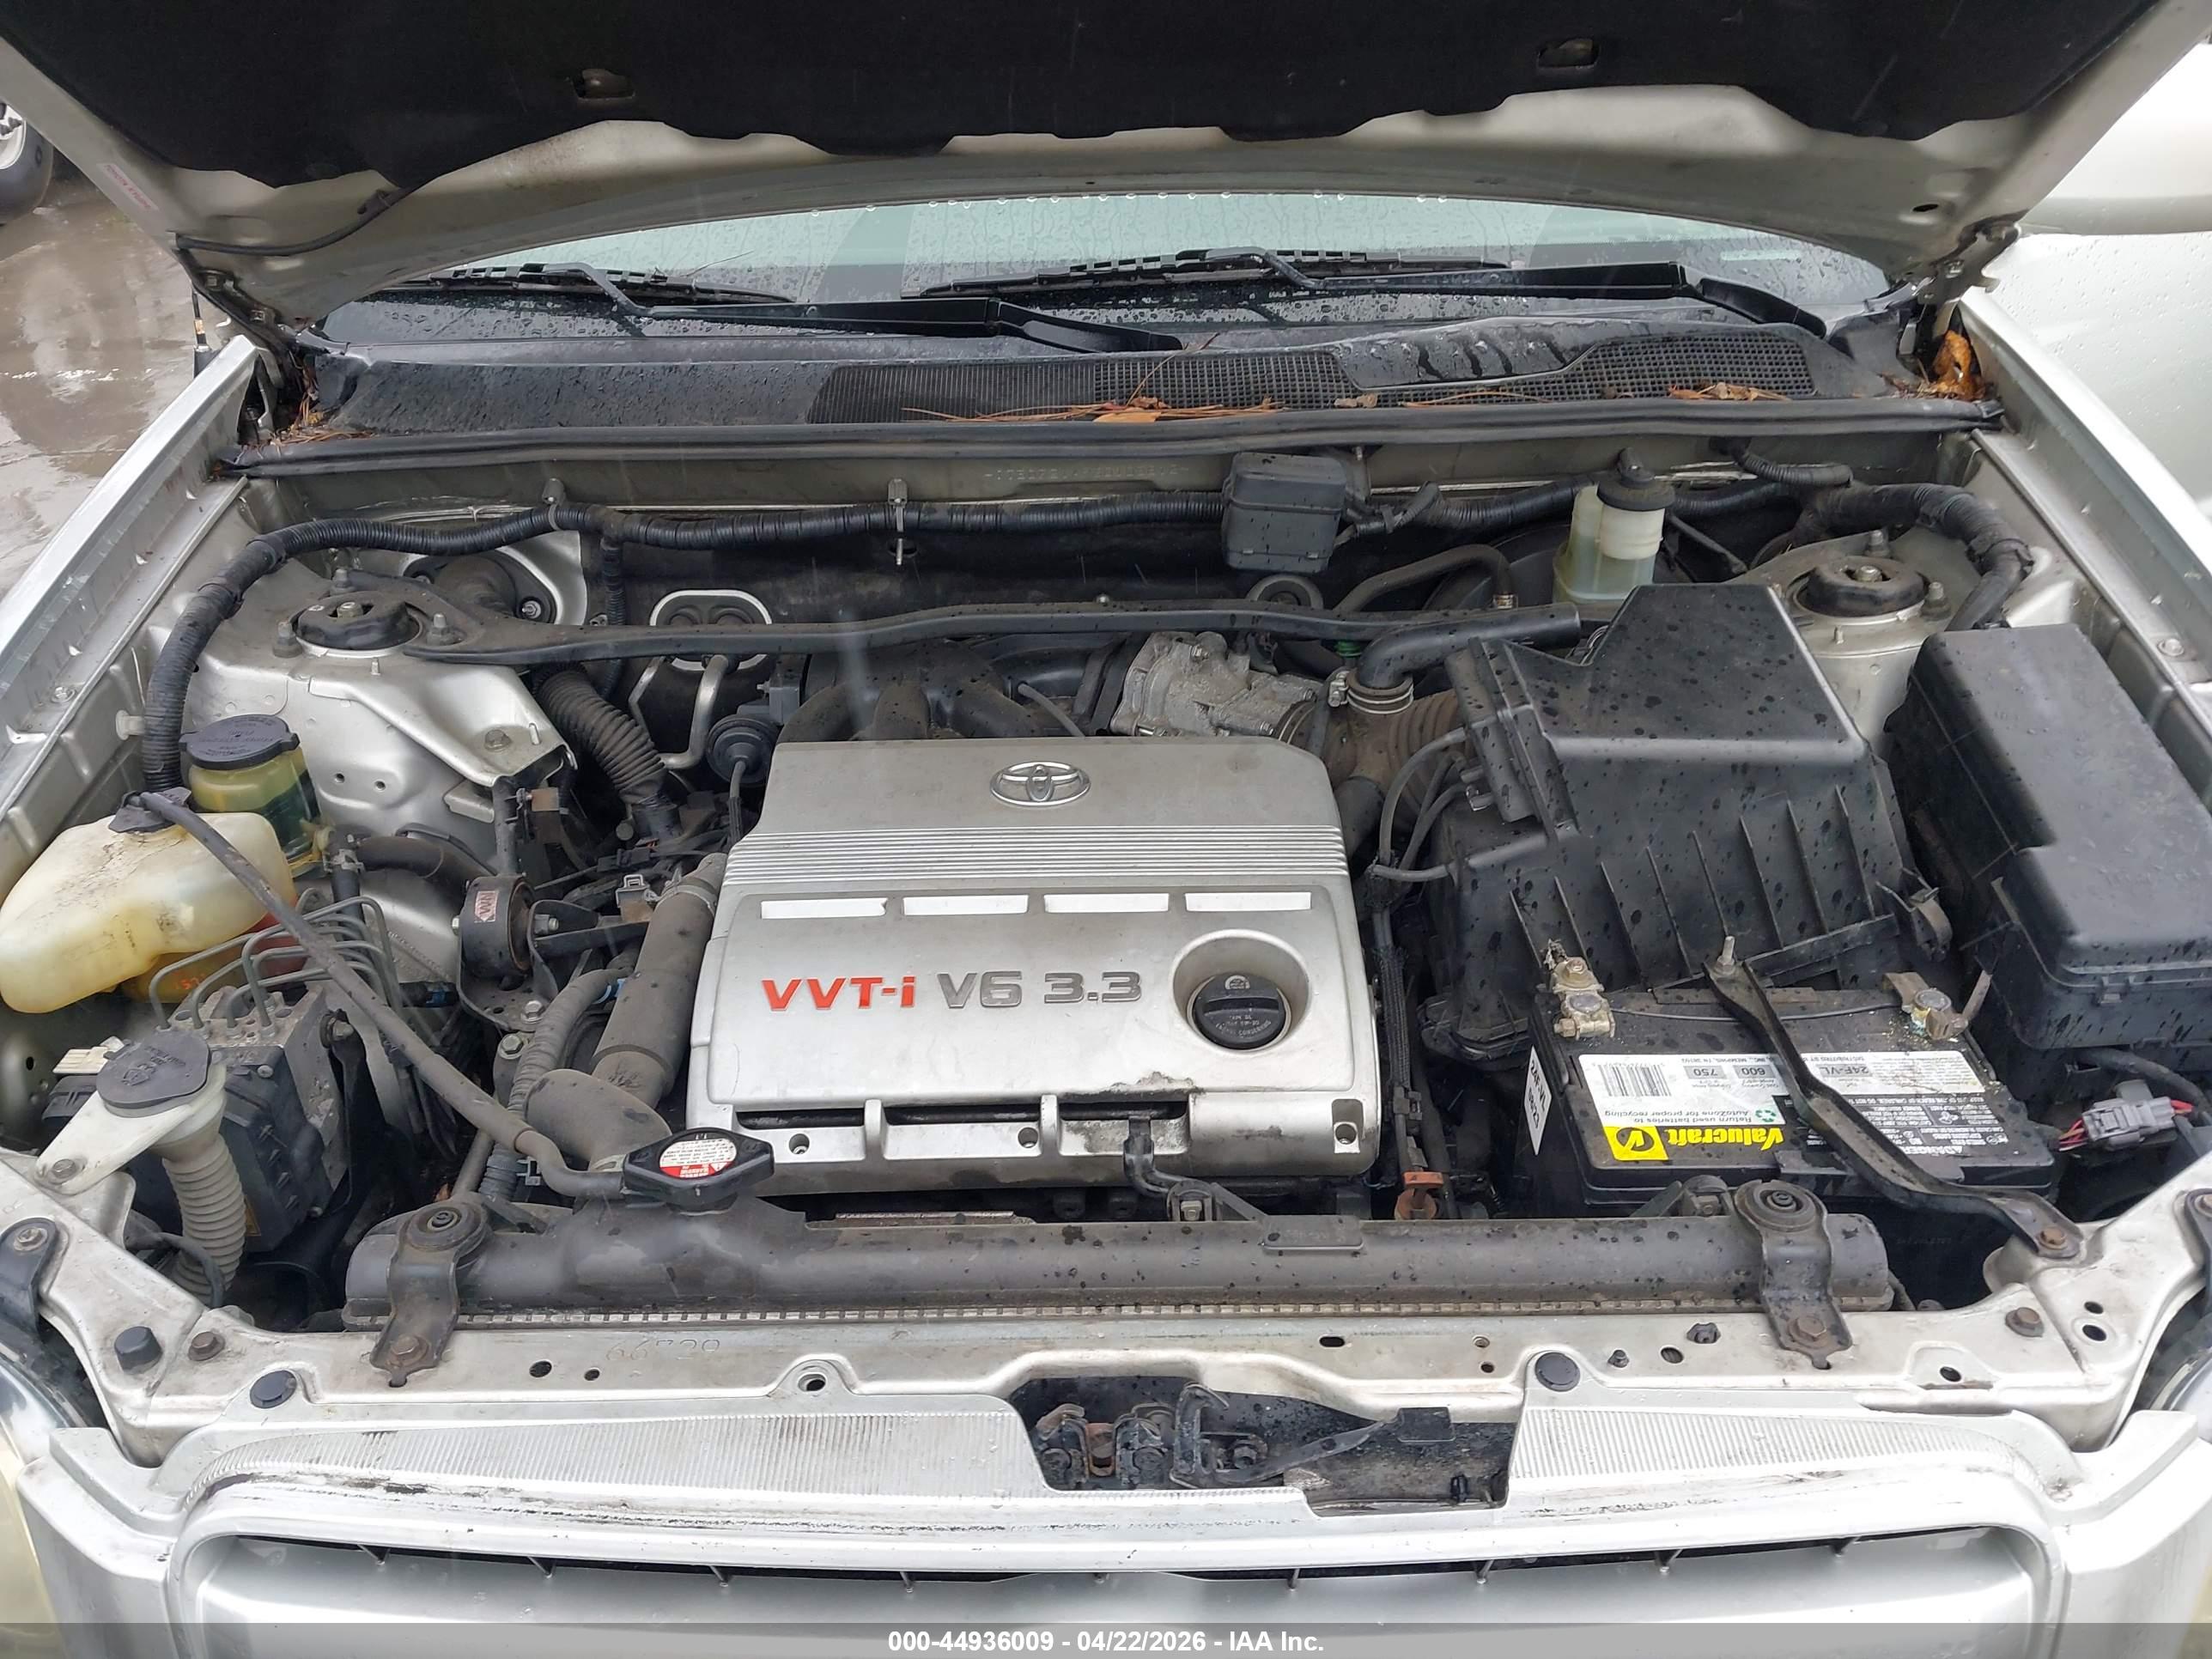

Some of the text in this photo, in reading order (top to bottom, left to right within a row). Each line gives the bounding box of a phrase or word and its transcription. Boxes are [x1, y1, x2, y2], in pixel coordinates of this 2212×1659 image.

[762, 970, 1142, 1012] VVT-i V6 3.3
[1741, 1067, 1765, 1076] 600
[1819, 1066, 1869, 1075] 24F-VL
[1668, 1127, 1784, 1152] Valucraft
